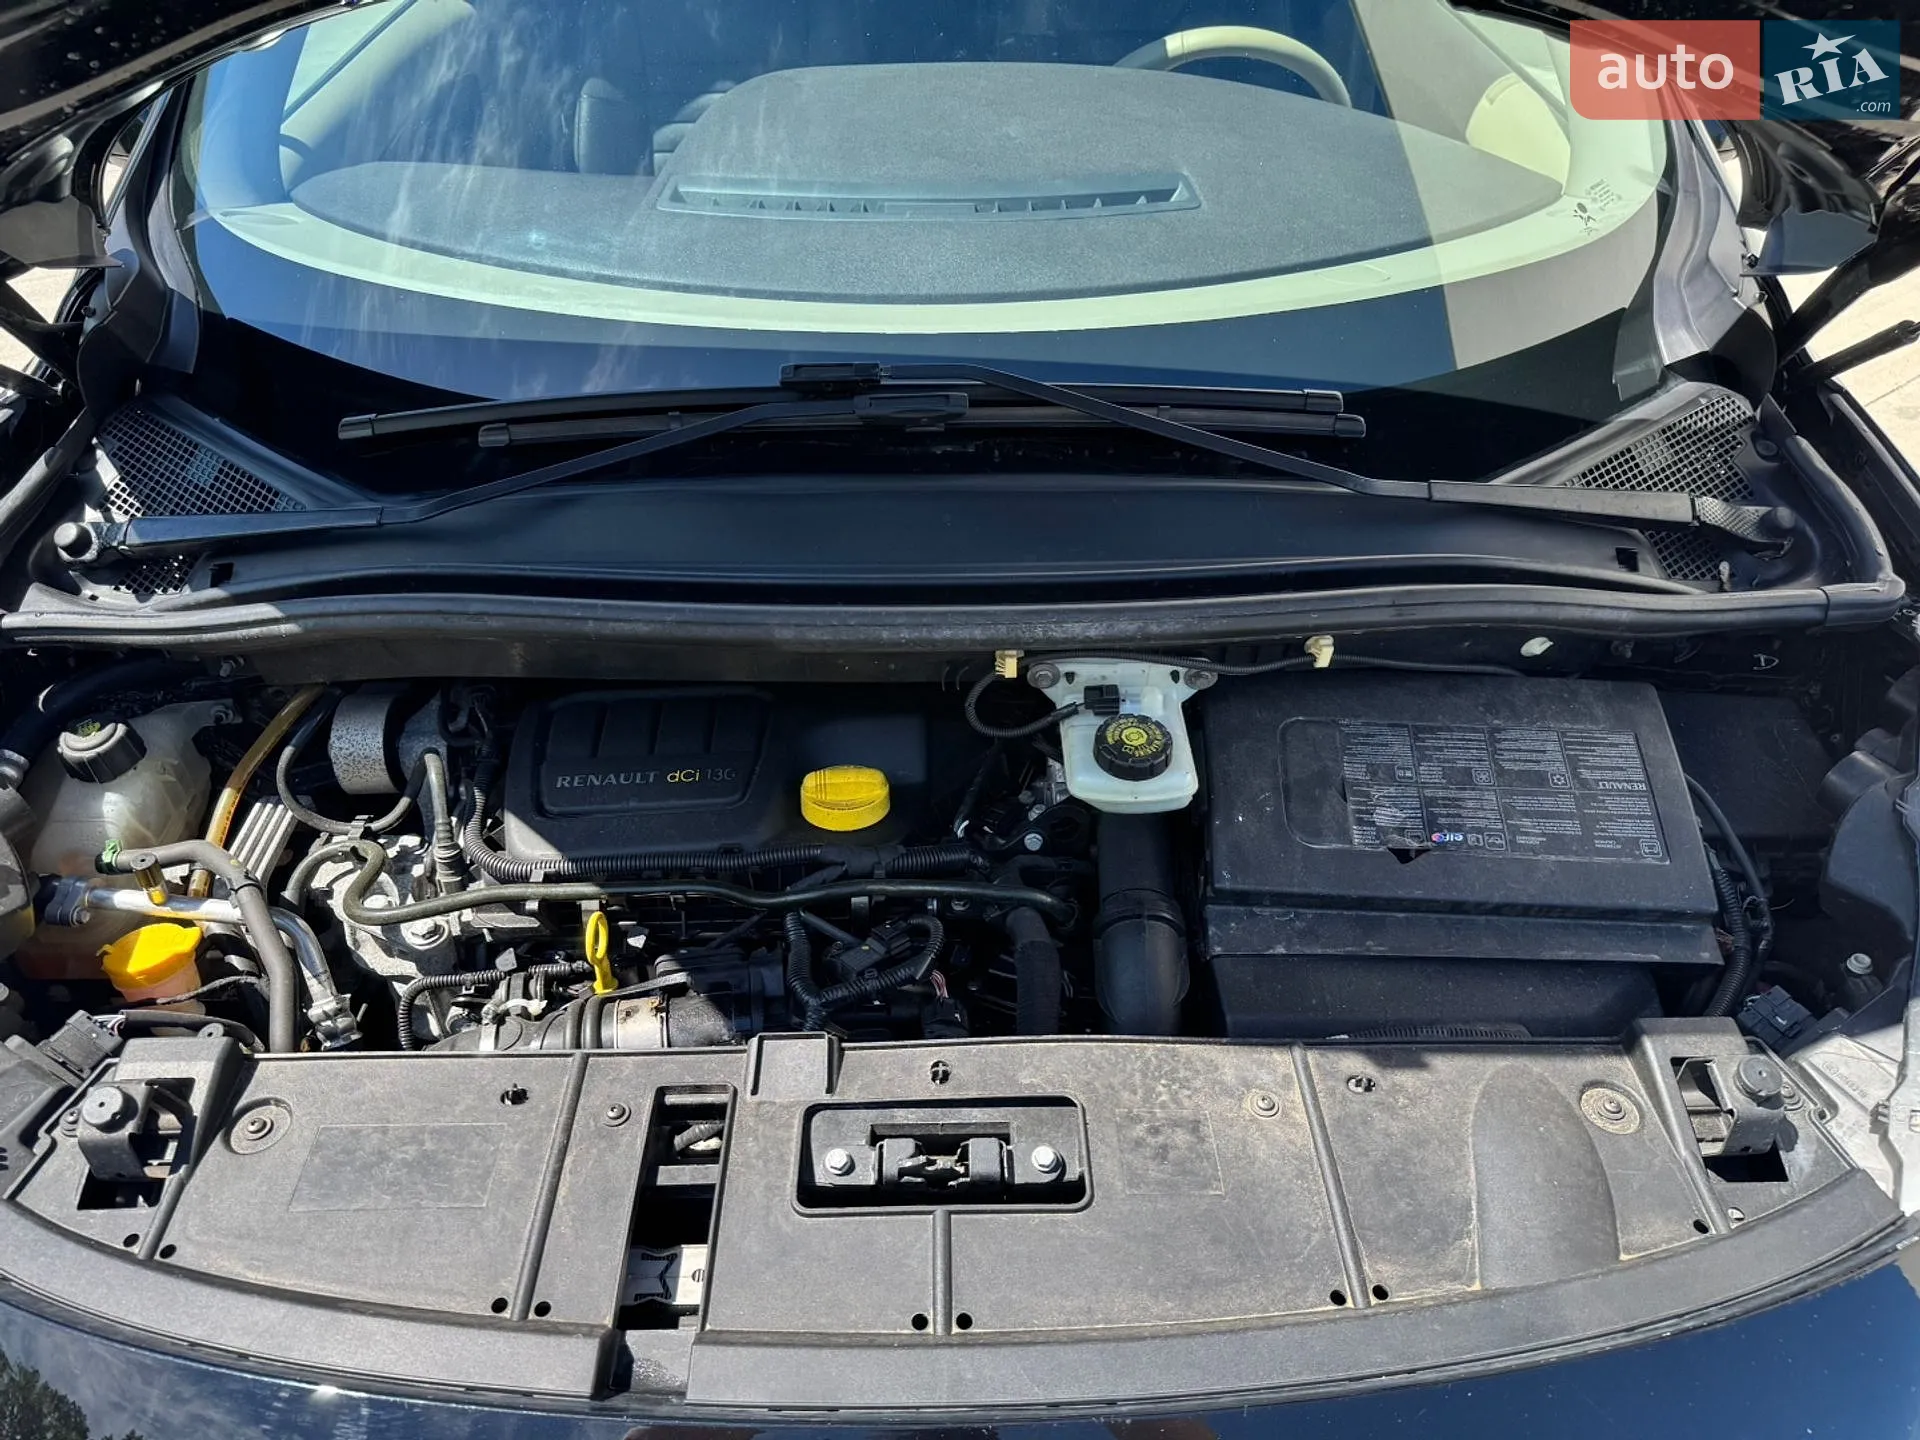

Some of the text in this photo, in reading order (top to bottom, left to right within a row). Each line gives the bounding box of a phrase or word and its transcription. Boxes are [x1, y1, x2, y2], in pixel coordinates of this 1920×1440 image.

[556, 771, 658, 788] RENAULT
[666, 768, 701, 784] dCi
[1597, 781, 1647, 791] RENAULT
